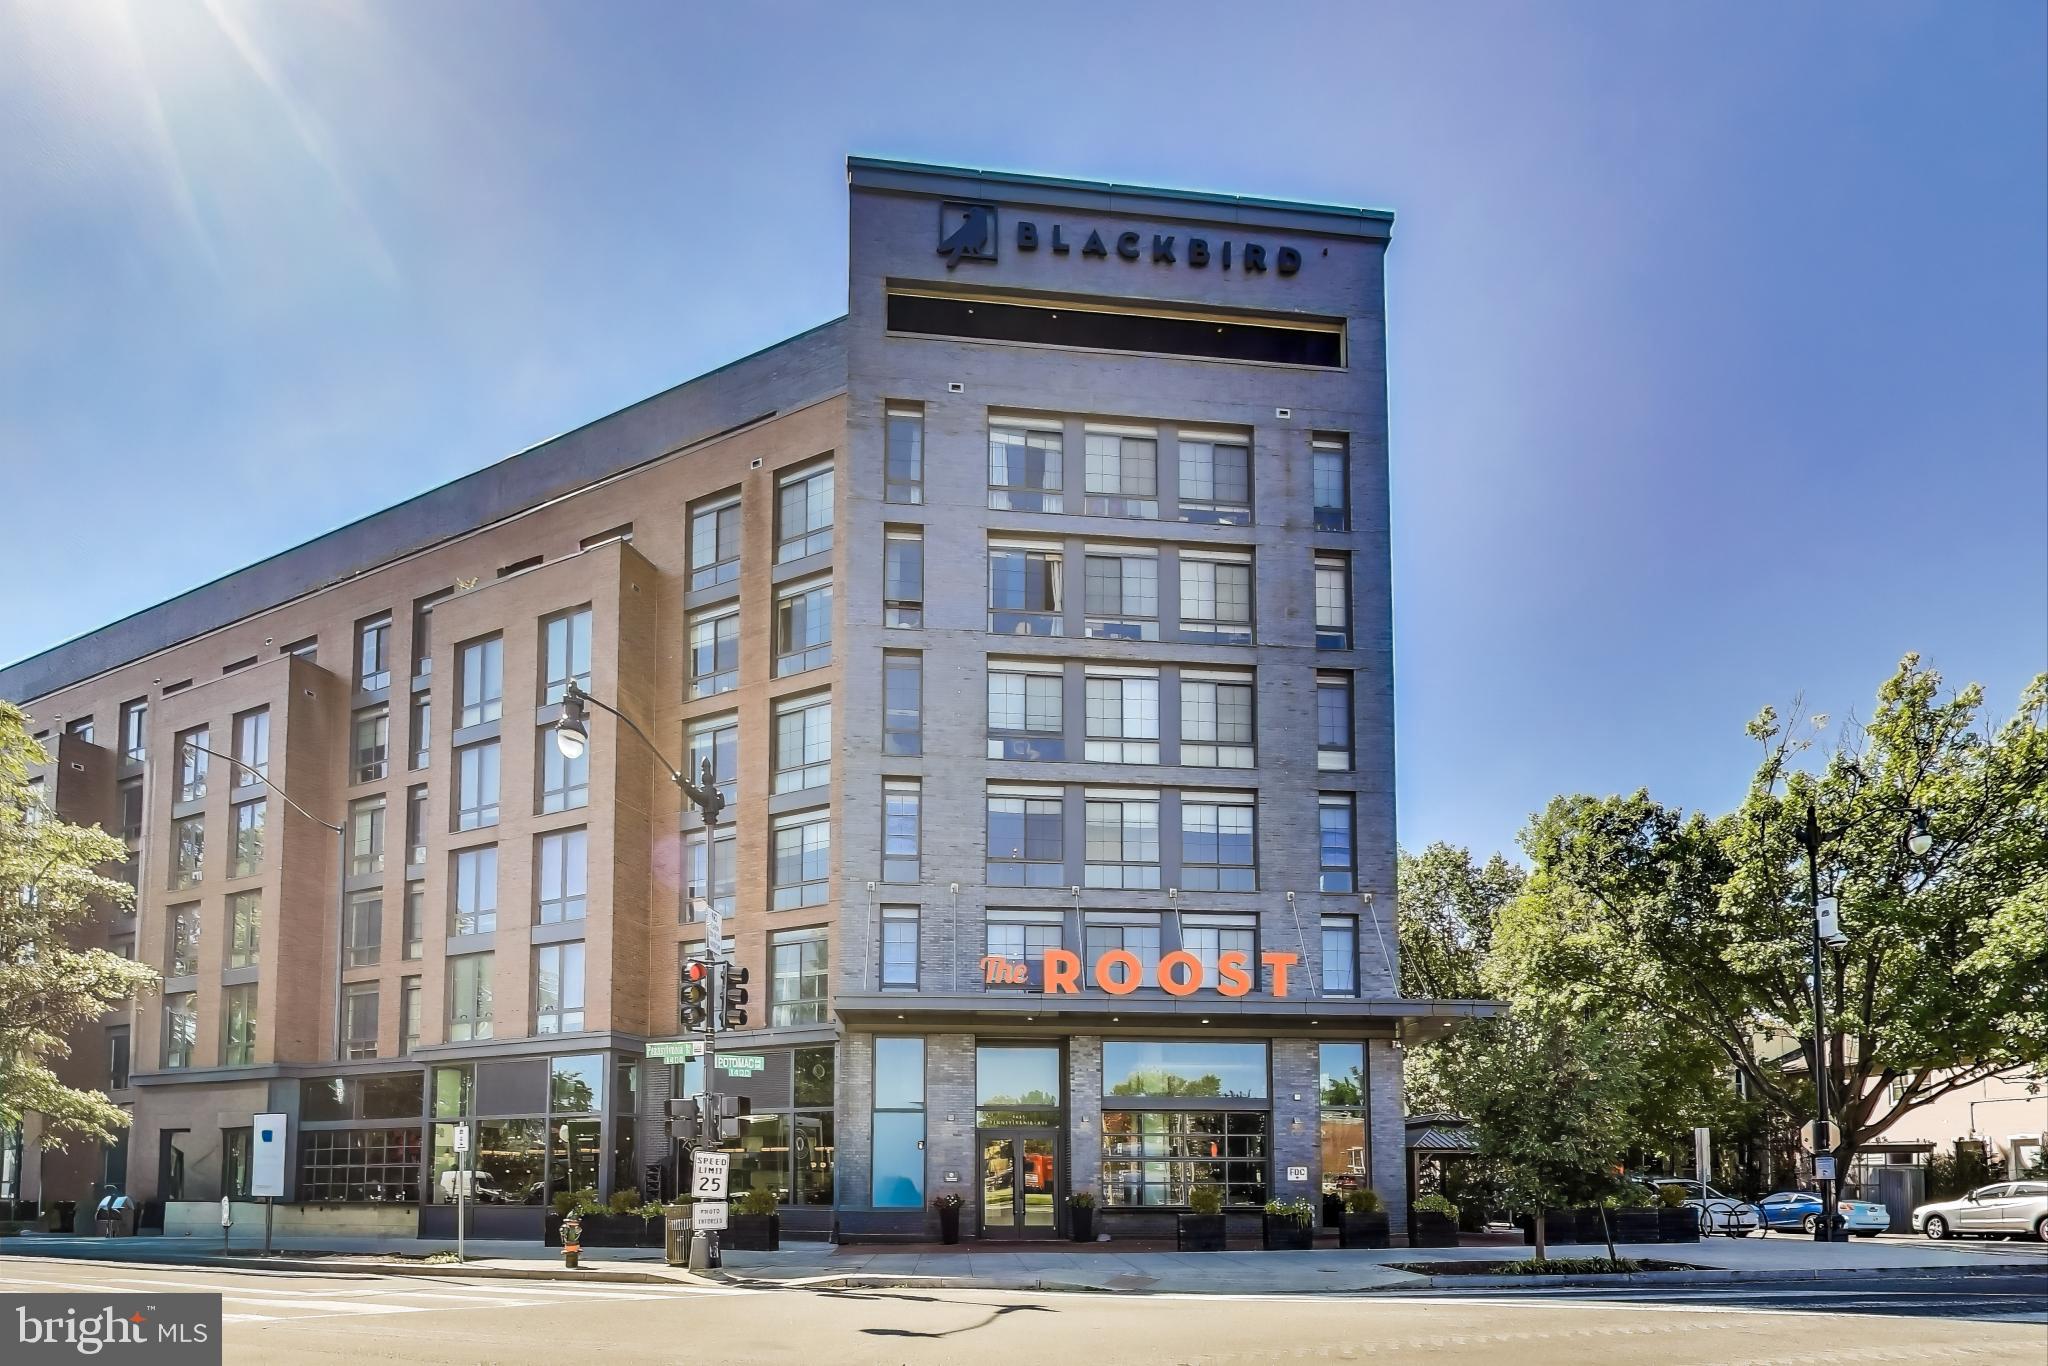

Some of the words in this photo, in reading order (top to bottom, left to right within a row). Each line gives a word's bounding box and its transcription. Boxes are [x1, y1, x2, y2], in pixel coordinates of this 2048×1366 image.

[1016, 221, 1302, 276] BLACKBIRD
[980, 956, 1029, 984] The
[1043, 949, 1298, 997] ROOST
[719, 1057, 753, 1068] POTOMAC
[697, 1157, 727, 1166] SPEED
[698, 1167, 722, 1175] LIMIT
[699, 1177, 721, 1192] 25
